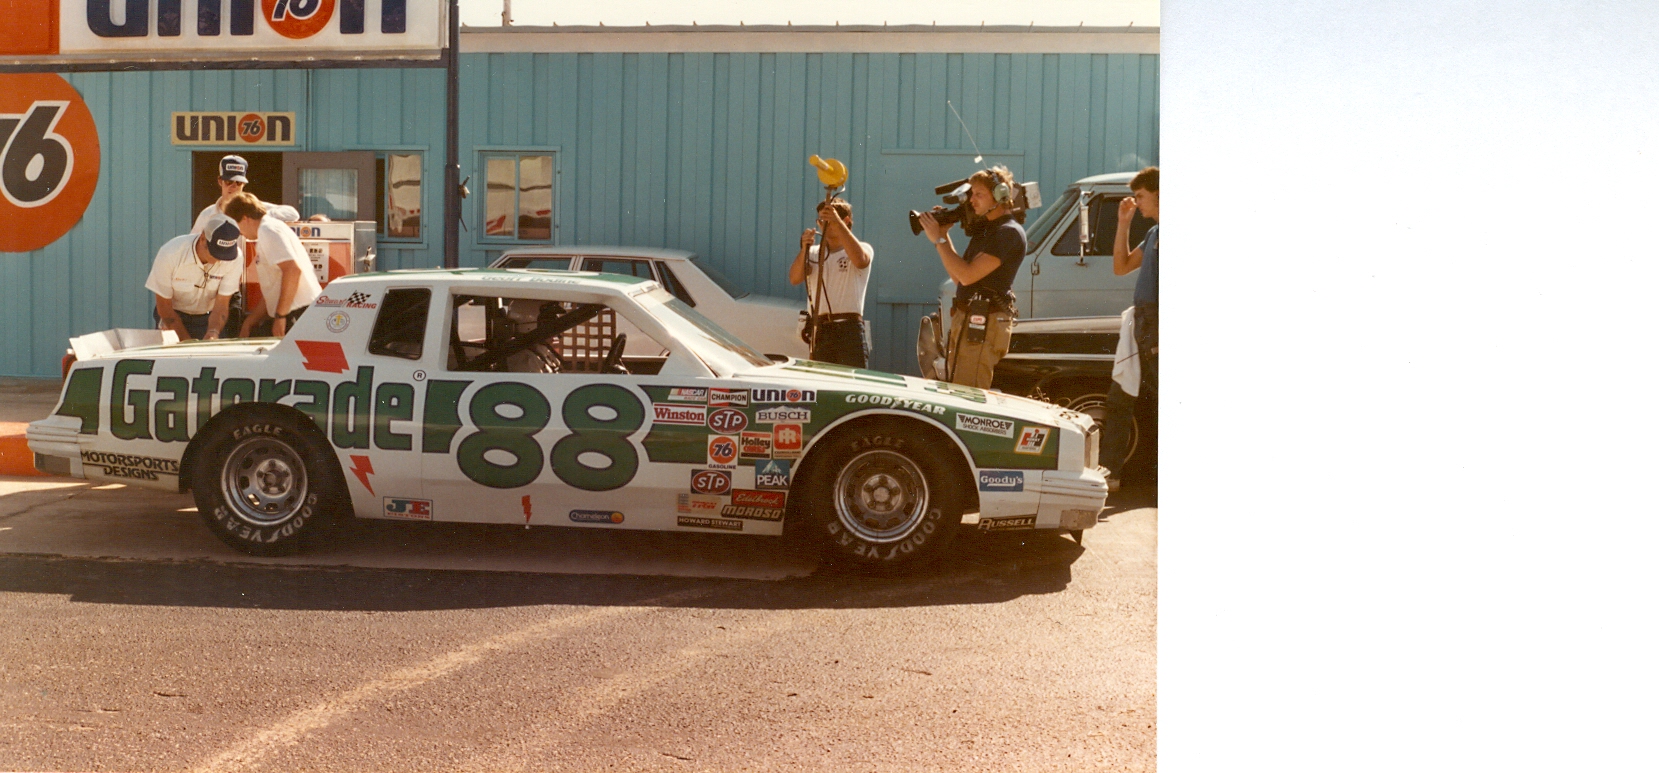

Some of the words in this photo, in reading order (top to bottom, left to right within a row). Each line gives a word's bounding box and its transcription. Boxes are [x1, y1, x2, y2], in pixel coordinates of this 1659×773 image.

[242, 120, 261, 136] 76
[346, 301, 377, 310] RACING
[711, 393, 747, 402] CHAMPION
[845, 393, 946, 415] GOODYEAR
[653, 407, 705, 421] Winston
[713, 411, 743, 429] STP
[758, 411, 808, 420] BUSCH
[964, 416, 1006, 430] MONROE
[233, 425, 283, 440] EAGLE
[457, 381, 646, 492] 88
[713, 441, 733, 458] 76
[741, 436, 771, 450] Holley
[80, 450, 180, 472] MOTORSPORTS
[103, 465, 160, 480] DESIGNS
[697, 473, 725, 490] STP
[757, 474, 788, 486] PEAK
[980, 475, 1023, 487] Goody's
[722, 505, 782, 519] MOROSO
[679, 517, 710, 525] HOWARD
[711, 519, 741, 527] STEWART
[978, 517, 1034, 530] RUSSELL
